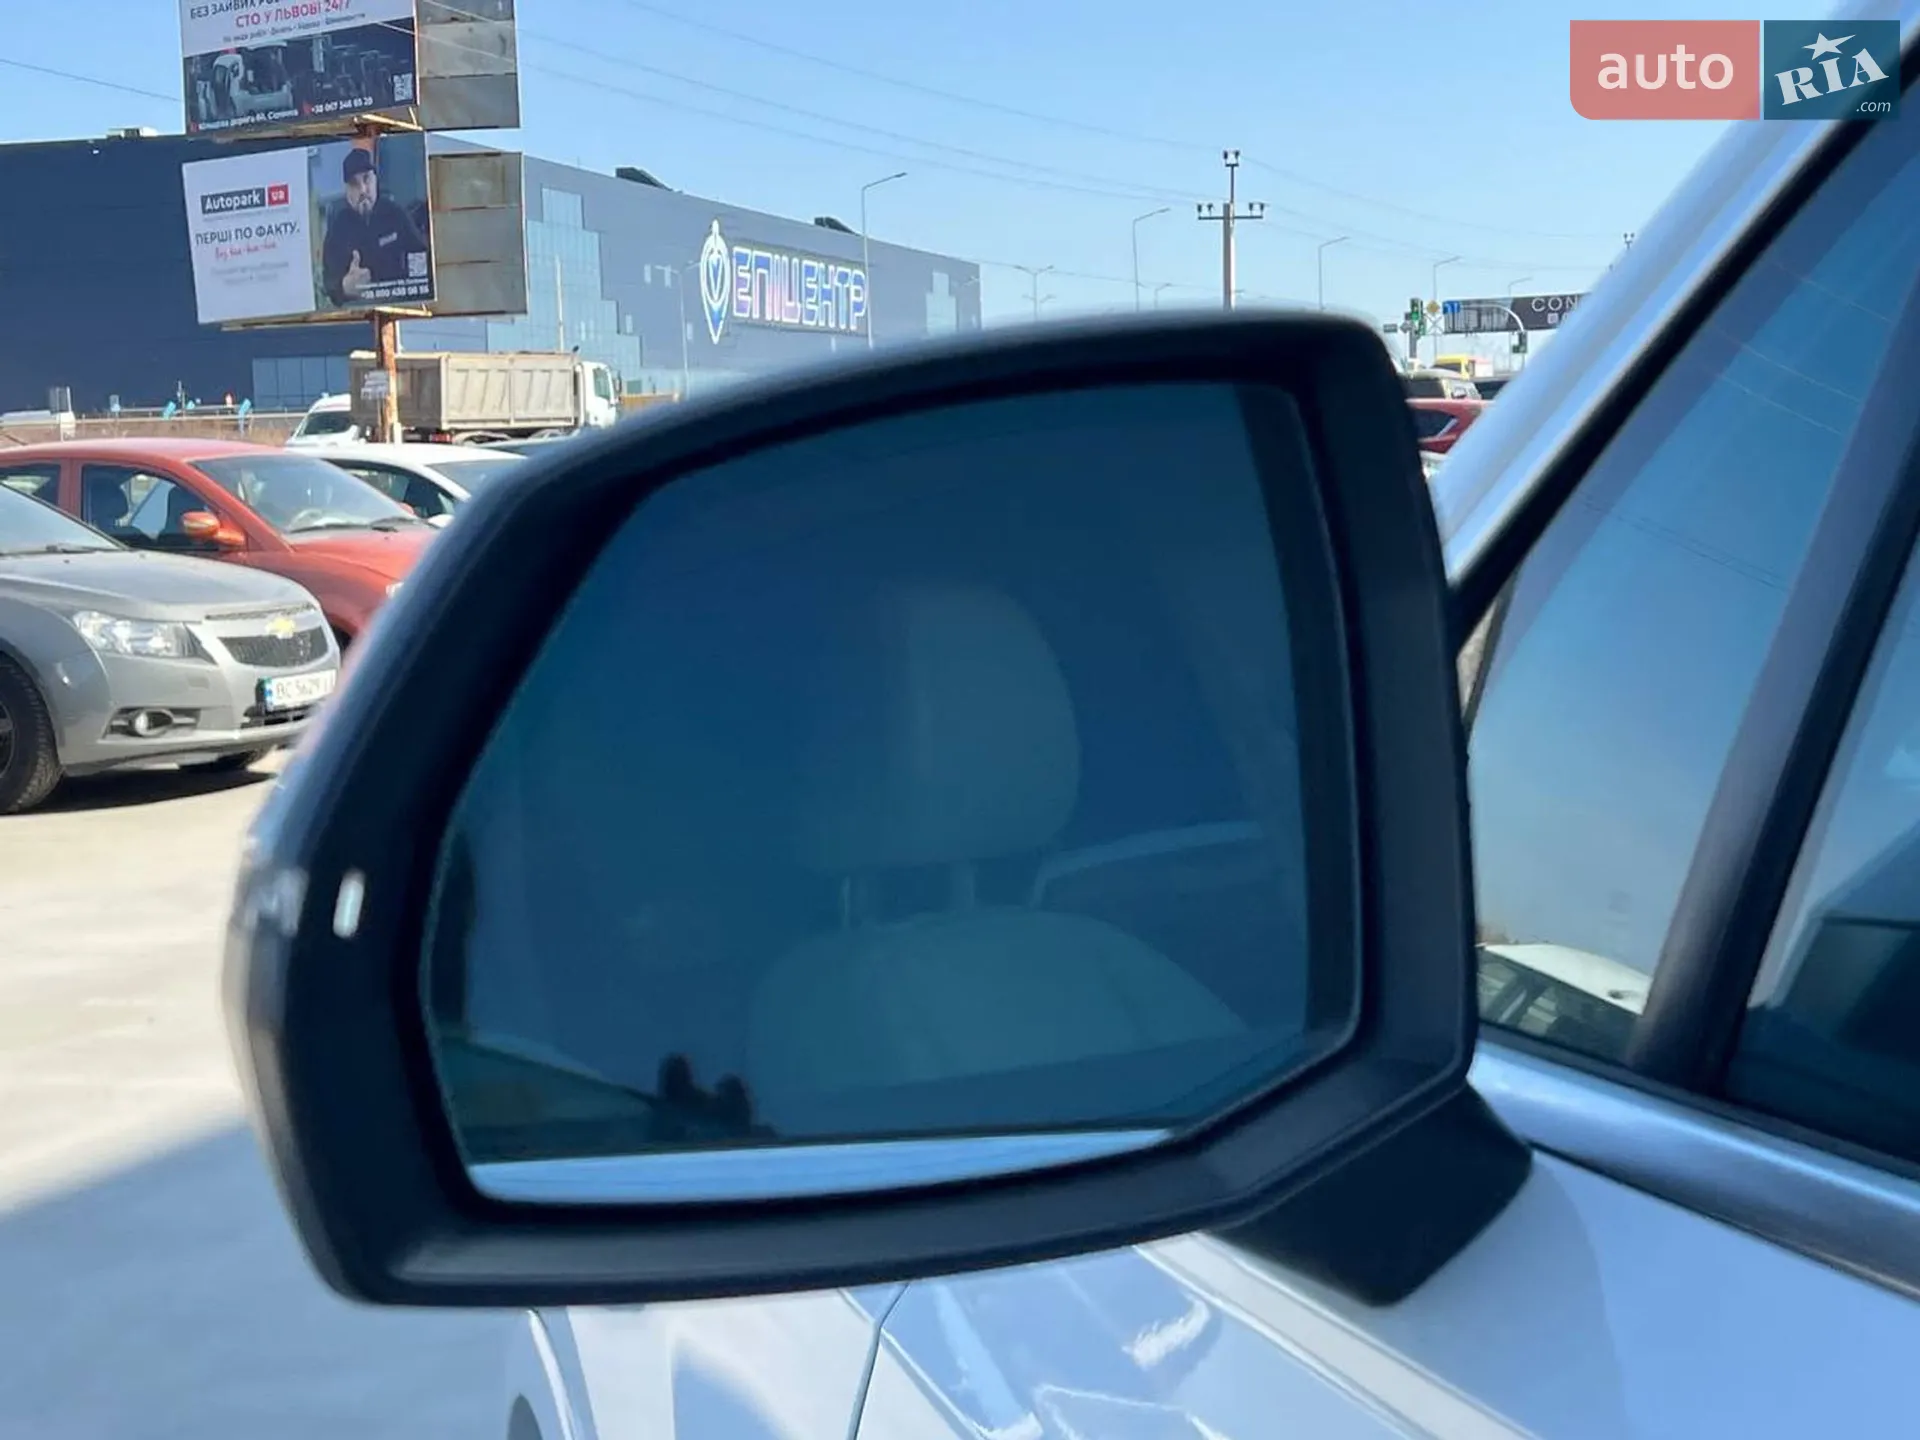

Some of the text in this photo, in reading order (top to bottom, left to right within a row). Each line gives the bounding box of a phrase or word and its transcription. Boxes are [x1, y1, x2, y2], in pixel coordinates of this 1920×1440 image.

[190, 6, 208, 19] БЕЗ
[236, 13, 261, 28] СТО
[264, 11, 272, 23] У
[275, 4, 321, 21] ЛЬВОВІ
[204, 189, 285, 213] Autopark ua
[195, 222, 300, 245] ПЕРШІ ПО ФАКТУ.
[732, 246, 866, 330] ЕПІЦЕНТР
